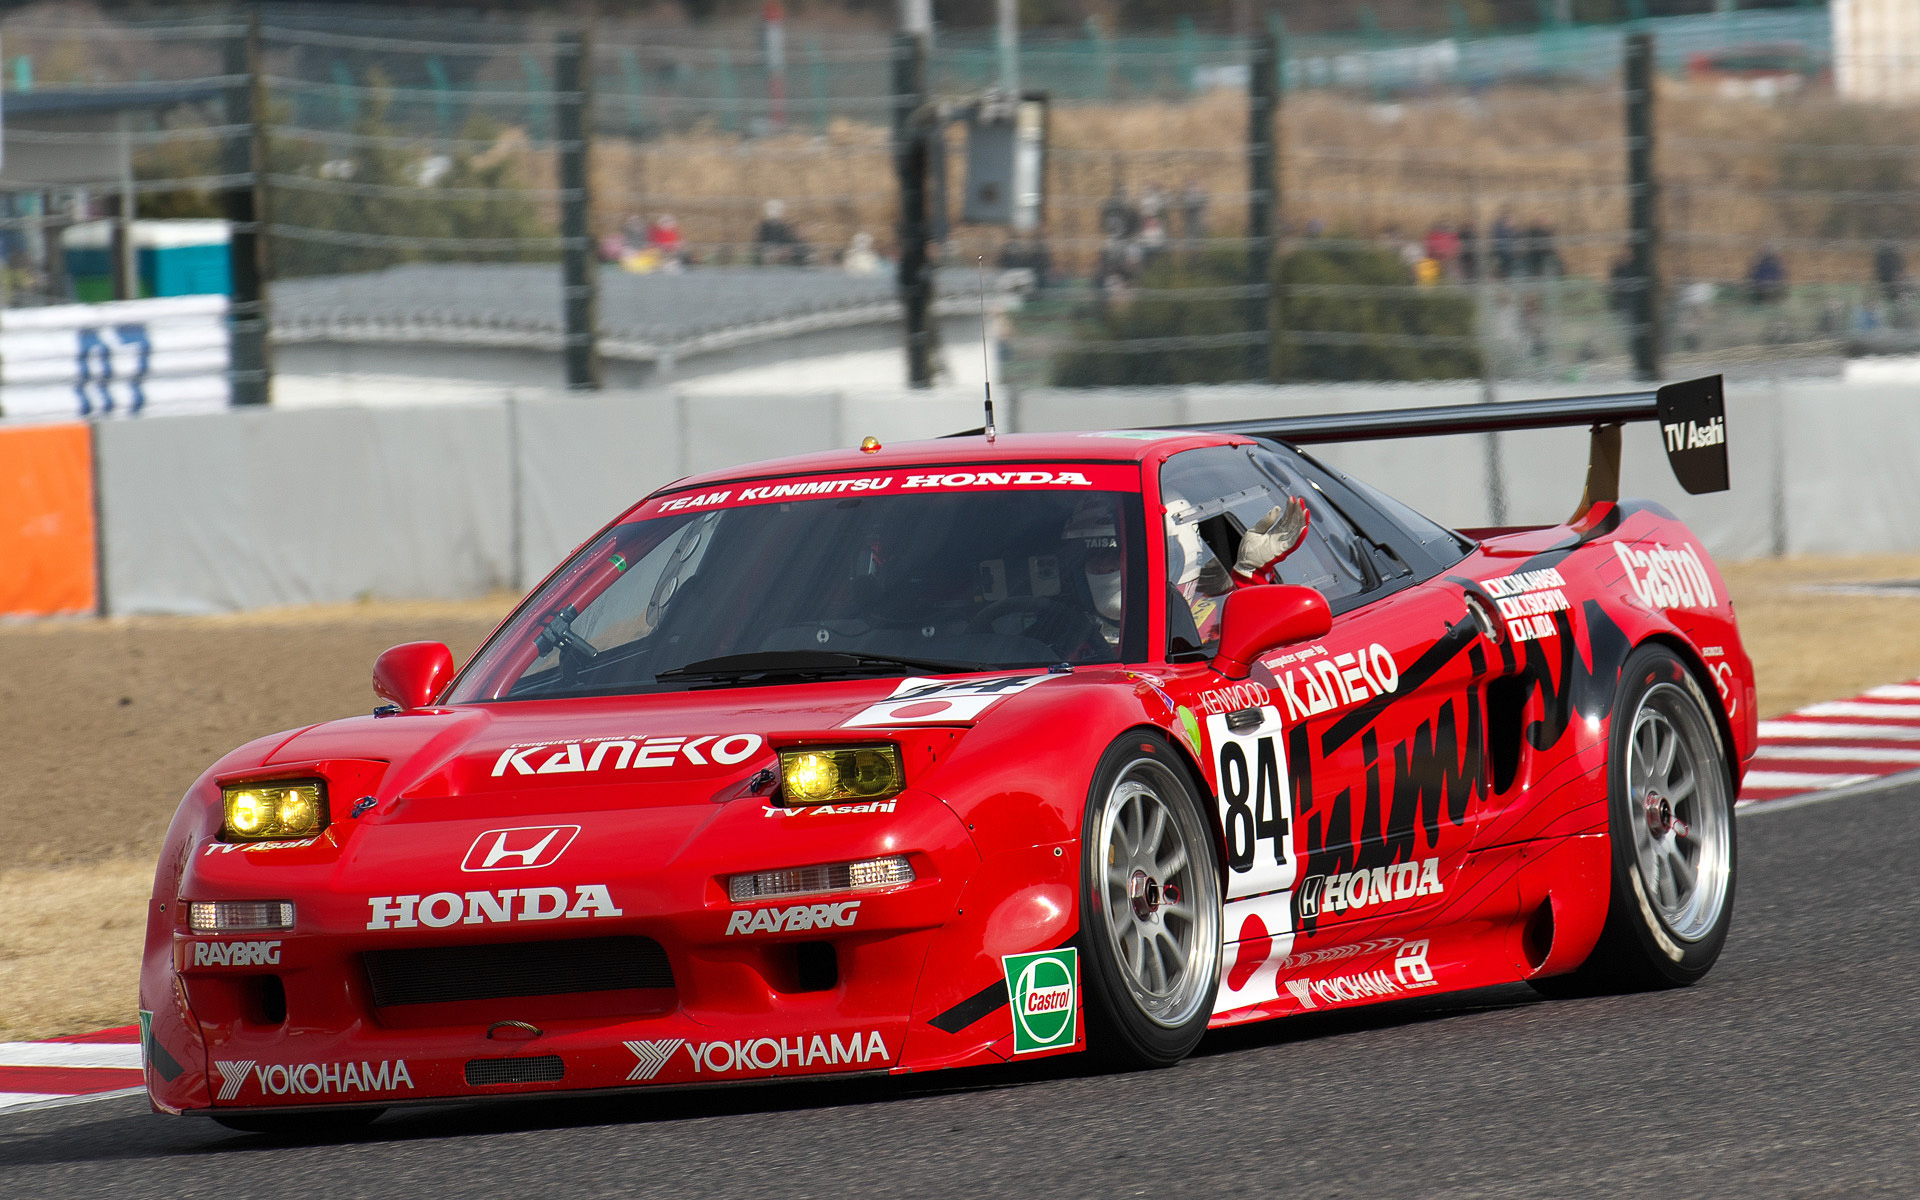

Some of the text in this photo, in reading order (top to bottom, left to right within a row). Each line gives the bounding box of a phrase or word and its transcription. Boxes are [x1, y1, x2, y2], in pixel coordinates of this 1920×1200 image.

[1664, 416, 1725, 453] TV Asahi
[658, 471, 1093, 513] TEAM KUNIMITSU HONDA
[1613, 541, 1718, 608] Castrol
[1196, 681, 1270, 715] KENWOOD
[1274, 643, 1399, 722] KANEKO
[491, 733, 763, 777] KANEKO
[762, 799, 897, 818] TV Asahi
[1220, 736, 1289, 874] 84
[204, 839, 317, 856] TV Asahi
[1321, 857, 1444, 913] HONDA
[366, 884, 623, 930] HONDA
[726, 900, 861, 936] RAYBRIG
[194, 940, 282, 967] RAYBRIG
[1028, 988, 1070, 1012] Castrol
[1308, 969, 1404, 1004] YOKOHAMA
[685, 1031, 889, 1073] YOKOHAMA
[255, 1059, 414, 1095] YOKOHAMA
